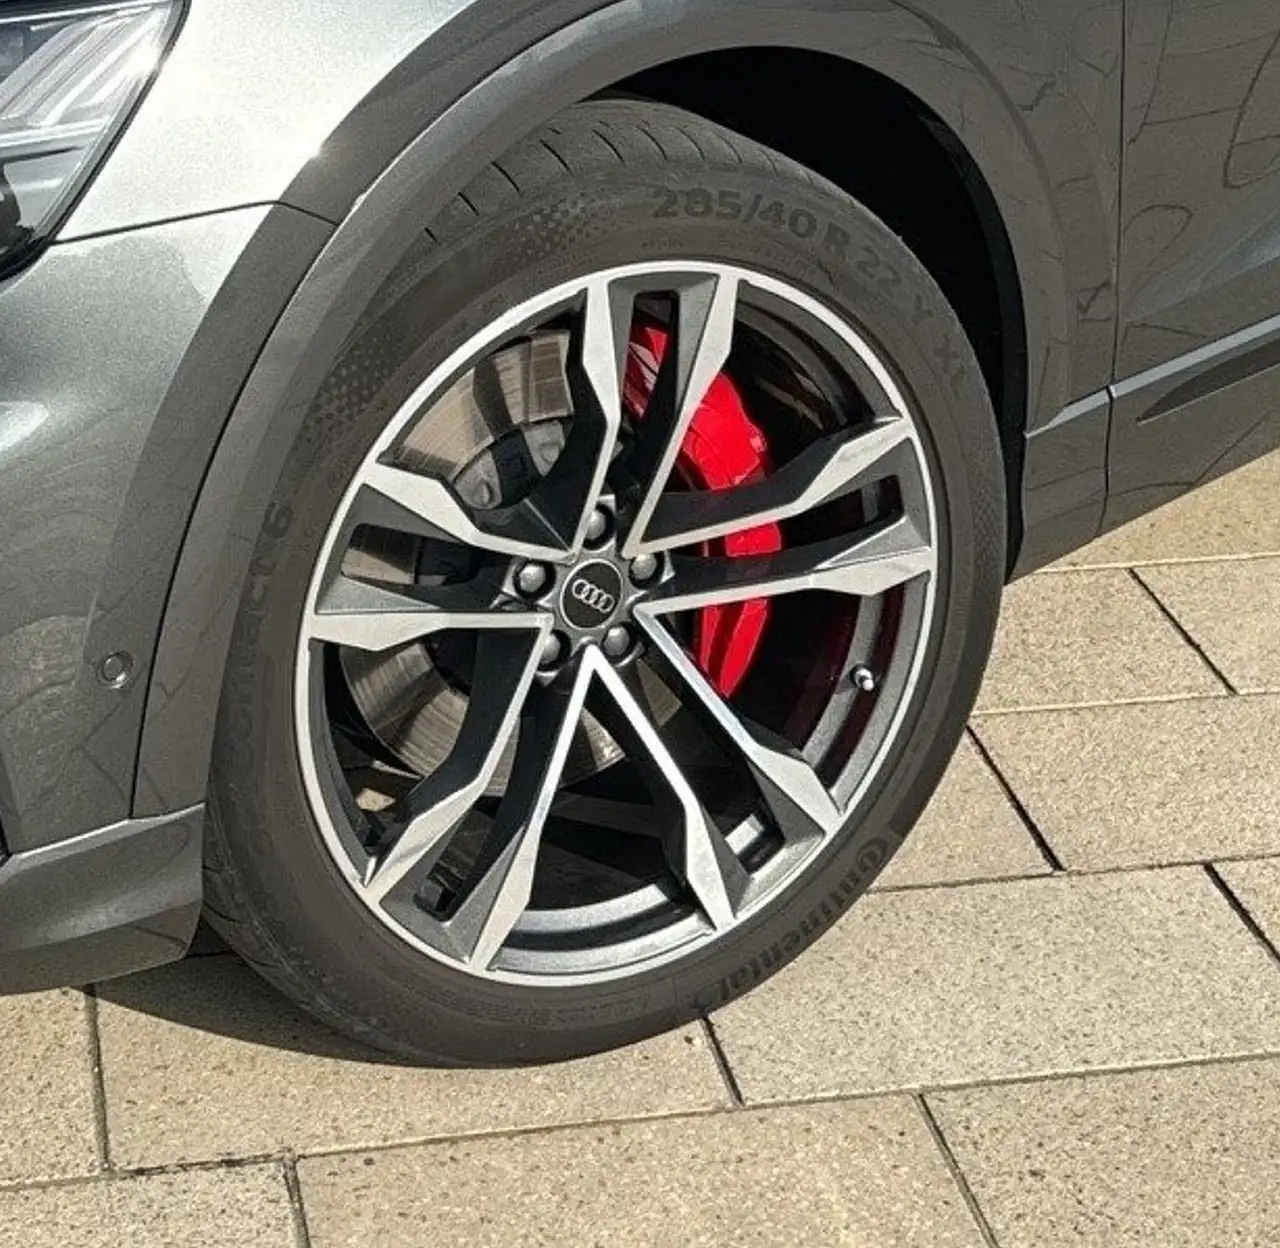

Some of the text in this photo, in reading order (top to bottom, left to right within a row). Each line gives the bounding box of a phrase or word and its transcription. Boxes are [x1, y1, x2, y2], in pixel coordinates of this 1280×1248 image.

[653, 188, 818, 240] 285/40
[822, 223, 852, 255] R
[858, 256, 903, 288] 22
[720, 837, 888, 1001] Continental
